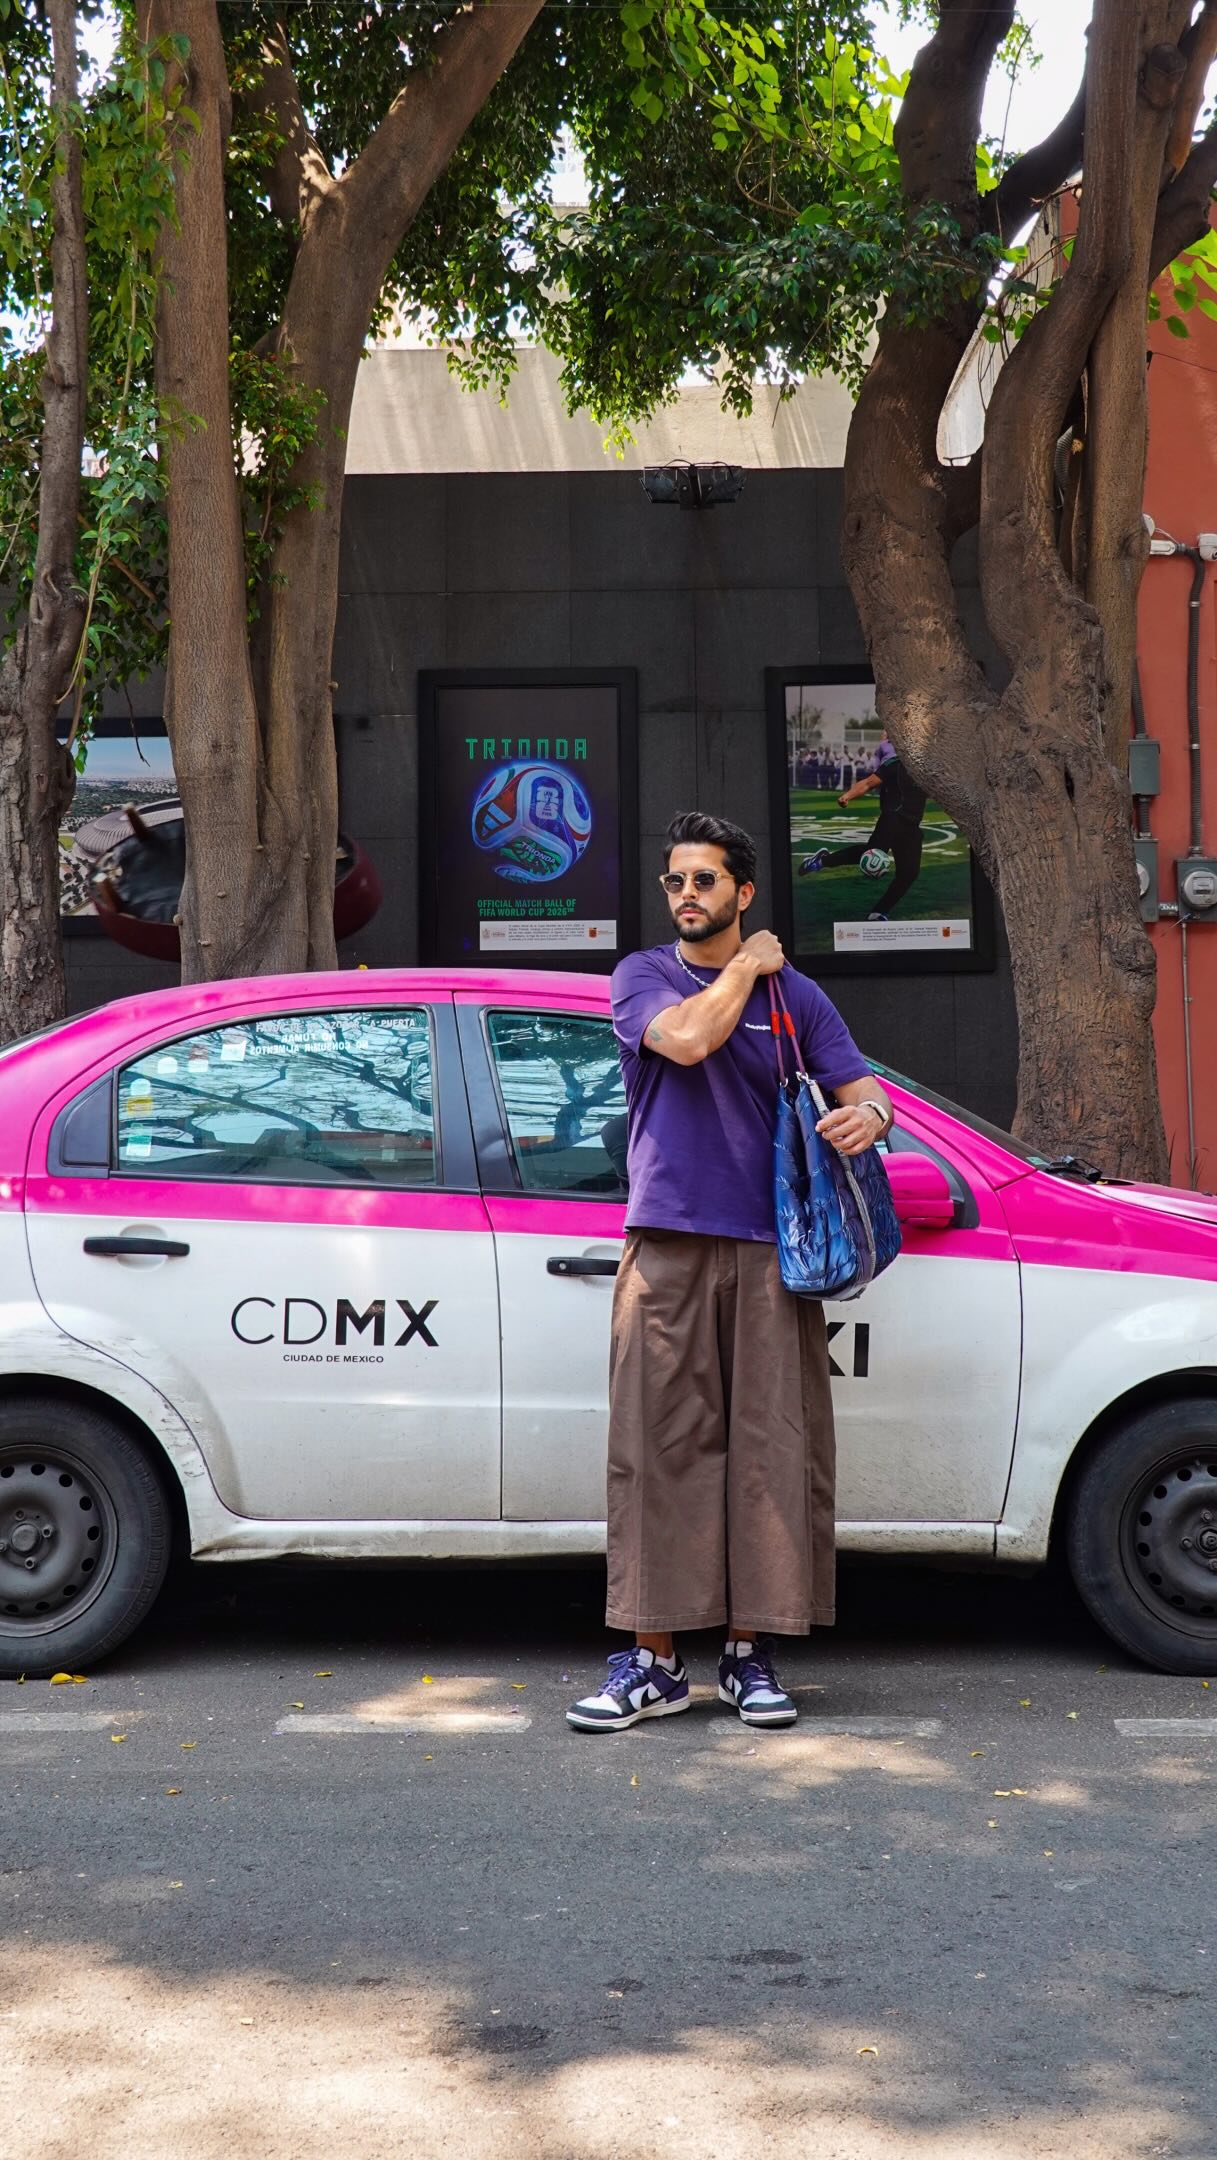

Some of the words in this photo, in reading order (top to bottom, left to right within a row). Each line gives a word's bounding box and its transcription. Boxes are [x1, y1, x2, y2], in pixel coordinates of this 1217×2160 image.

[465, 738, 588, 760] TRIONDA
[477, 899, 513, 908] OFFICIAL
[515, 899, 542, 908] MATCH
[545, 899, 564, 908] BALL
[566, 898, 577, 907] OF
[479, 908, 496, 917] FIFA
[498, 908, 526, 917] WORLD
[528, 908, 545, 916] CUP
[231, 1296, 440, 1347] CDMX
[283, 1354, 323, 1362] CIUDAD
[343, 1355, 385, 1363] MEXICO
